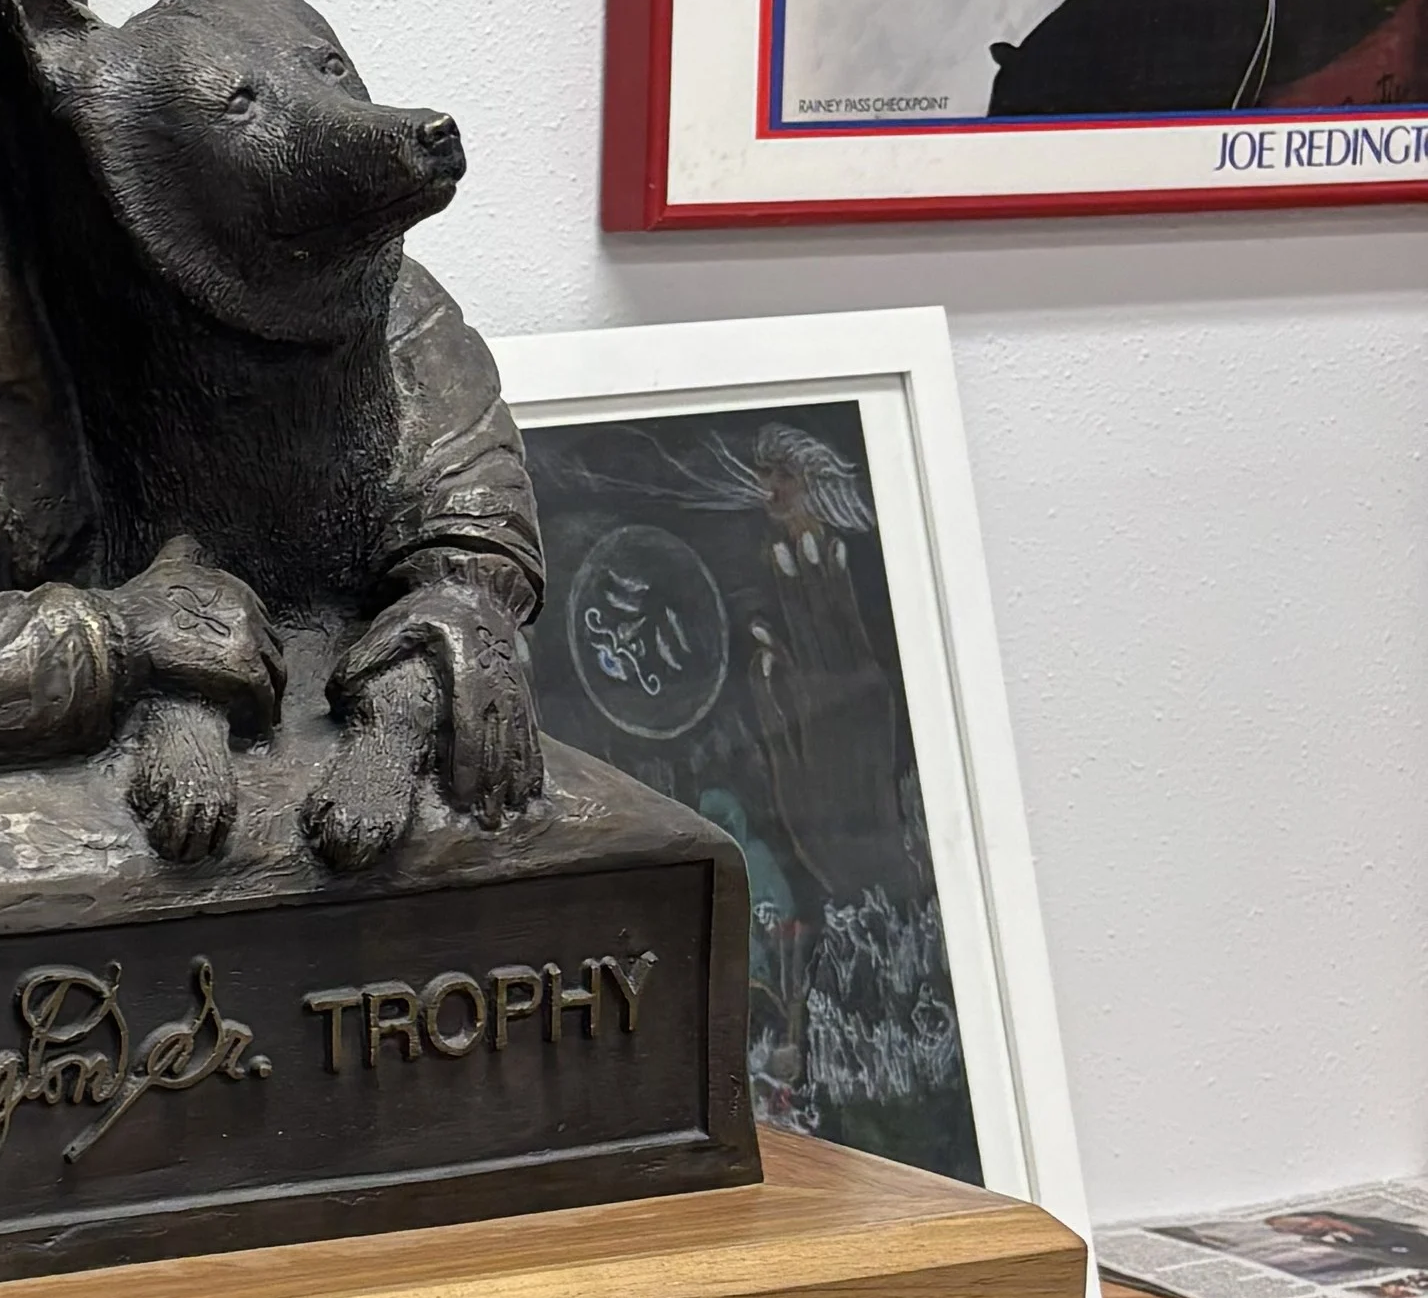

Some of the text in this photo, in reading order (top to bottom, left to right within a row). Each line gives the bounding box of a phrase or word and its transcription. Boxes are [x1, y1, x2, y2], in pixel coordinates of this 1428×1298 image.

[798, 96, 950, 114] RAINEY PASS CHECKPOINT
[1213, 125, 1428, 171] JOE REDINGT
[306, 949, 661, 1069] TROPHY
